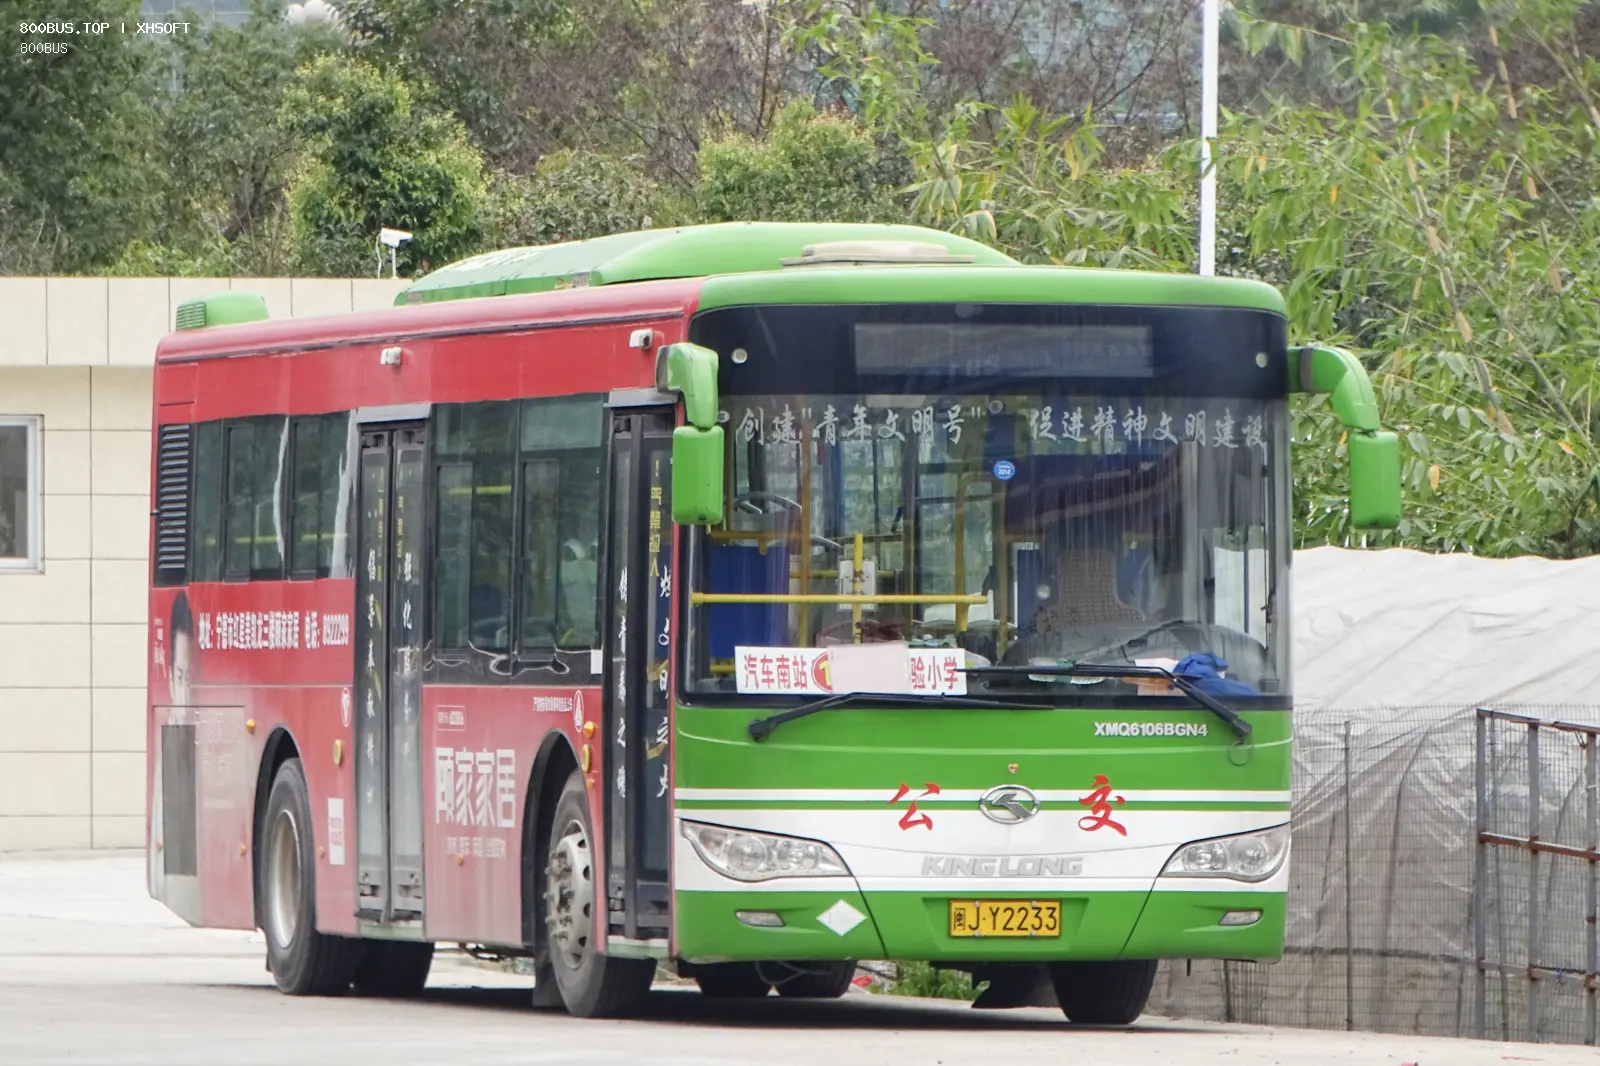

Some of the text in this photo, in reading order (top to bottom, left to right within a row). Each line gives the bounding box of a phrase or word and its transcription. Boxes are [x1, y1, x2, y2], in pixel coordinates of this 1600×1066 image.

[1030, 405, 1267, 449] 促进精神文明建设
[744, 654, 808, 690] 汽车南站
[1094, 721, 1208, 737] XMQ6106BGN4
[435, 746, 516, 829] 顾家家居
[887, 774, 1128, 837] 公 交
